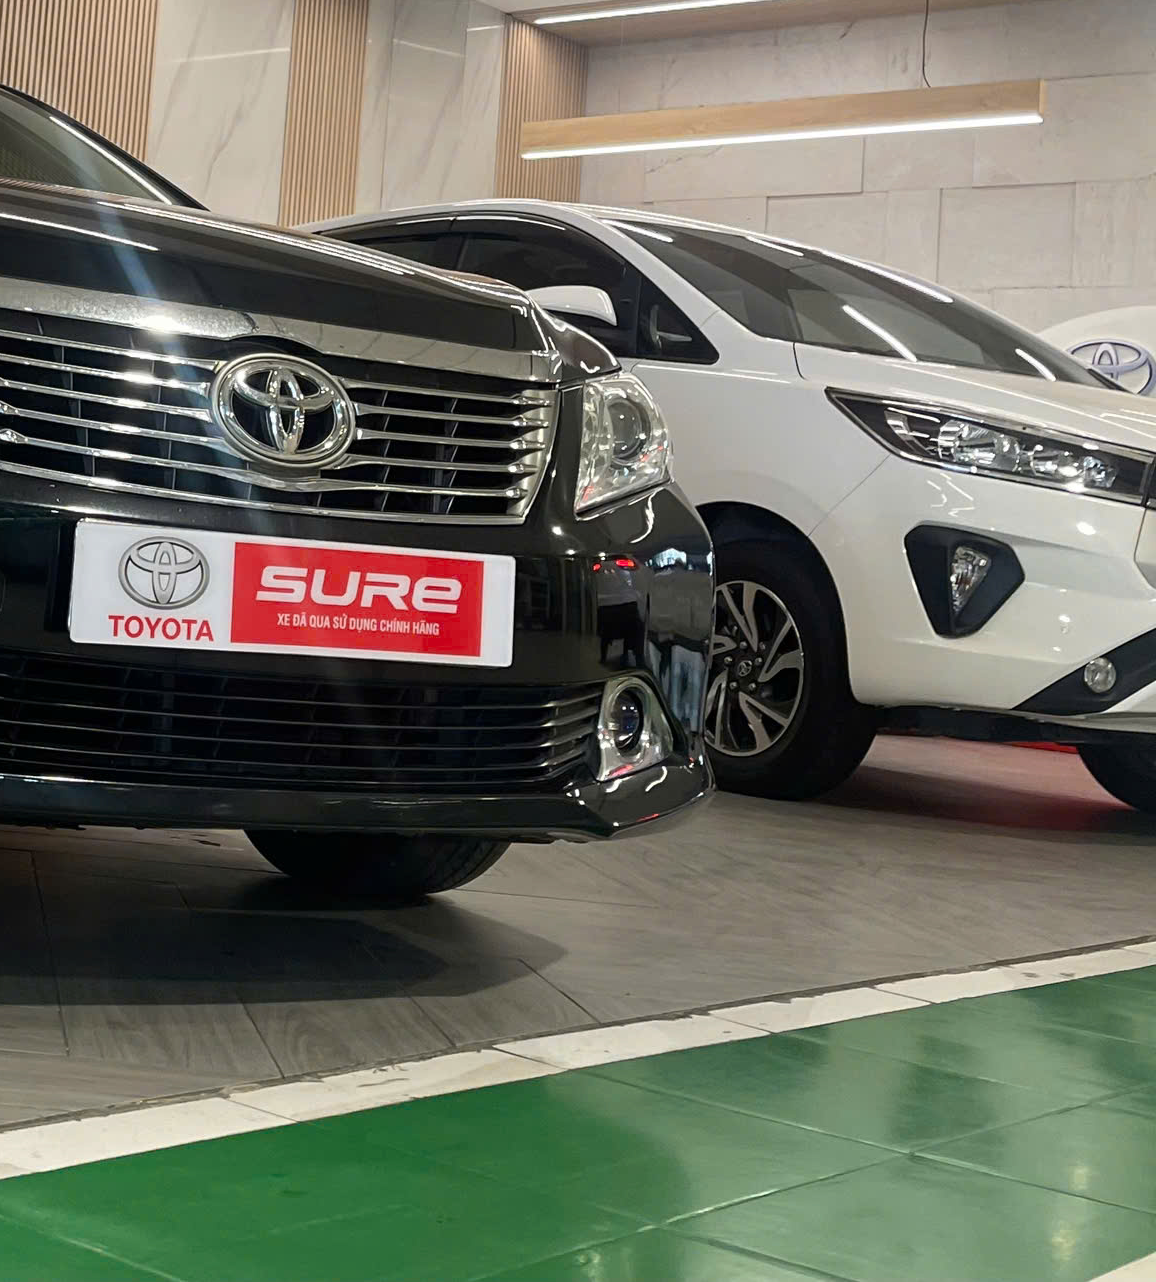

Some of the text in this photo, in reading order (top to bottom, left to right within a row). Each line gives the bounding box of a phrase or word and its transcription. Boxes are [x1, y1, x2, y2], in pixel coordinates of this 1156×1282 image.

[108, 615, 214, 642] TOYOTA
[277, 613, 291, 626] XE
[292, 612, 307, 627] ĐÃ
[309, 615, 331, 629] QUA
[332, 613, 348, 630] SỬ
[349, 617, 377, 633] DỤNG
[379, 617, 410, 634] CHÍNH
